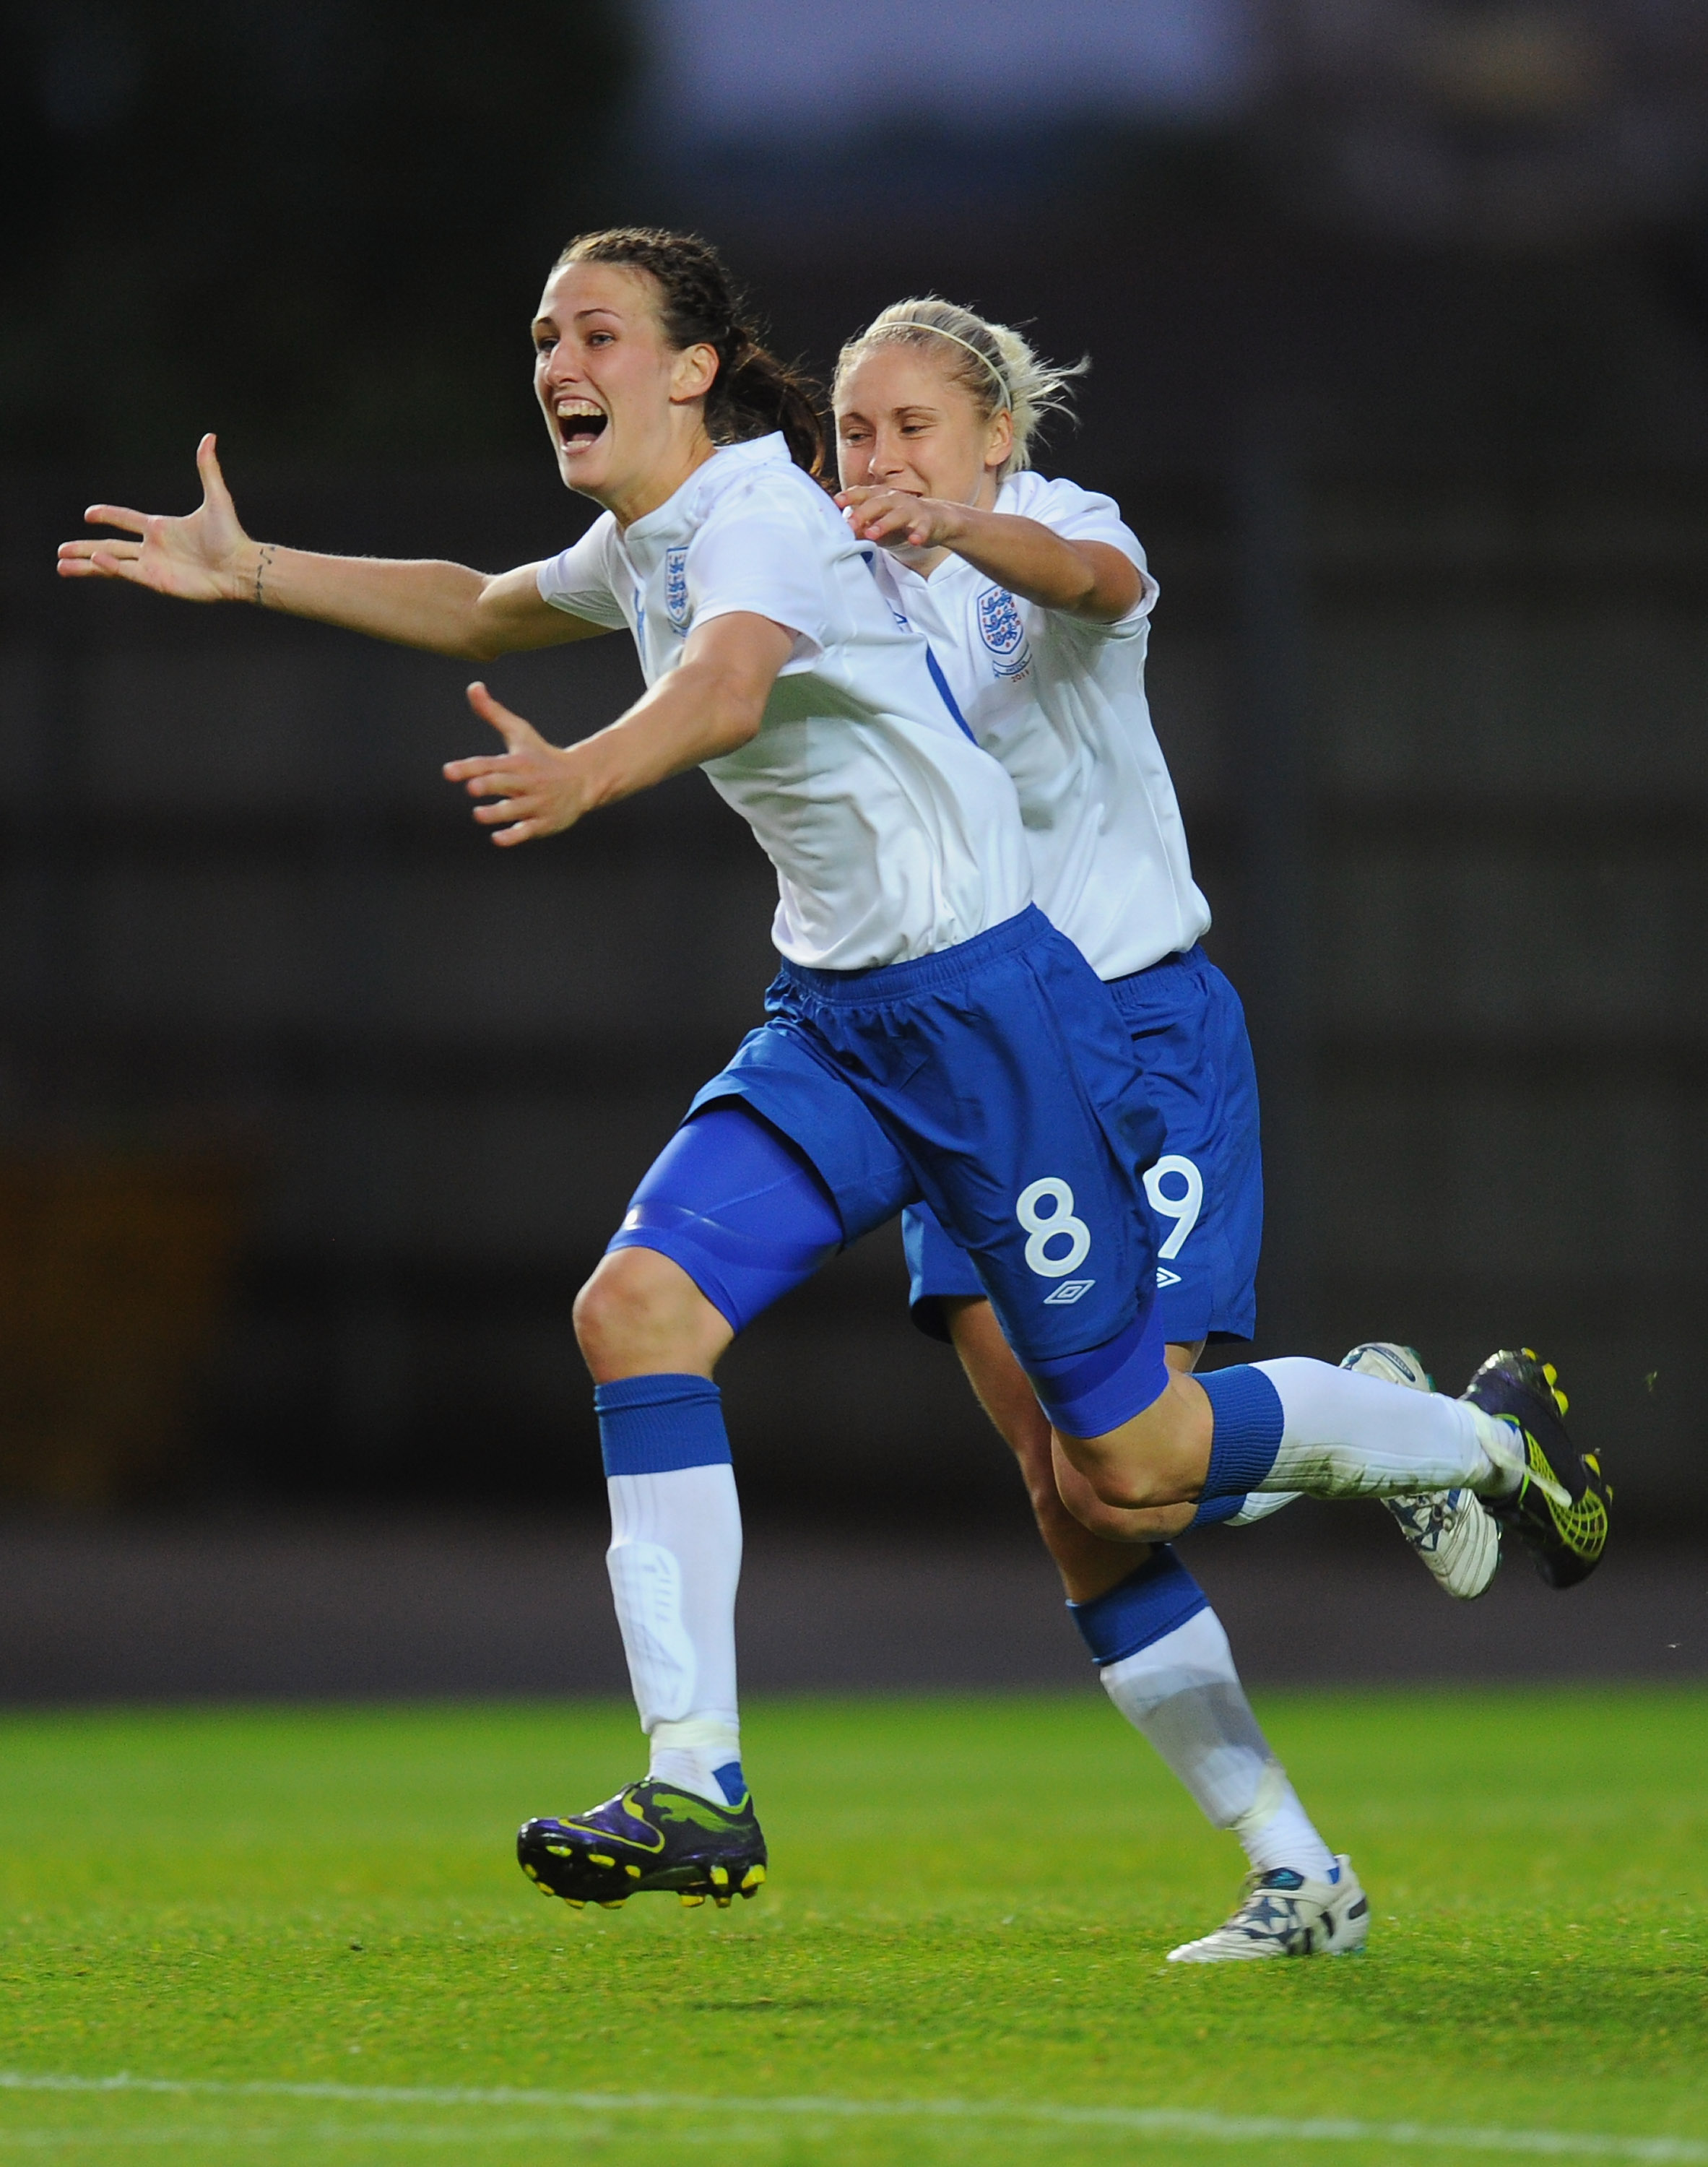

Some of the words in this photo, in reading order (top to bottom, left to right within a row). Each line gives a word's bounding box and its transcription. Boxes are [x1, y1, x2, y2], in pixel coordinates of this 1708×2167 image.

[1011, 669, 1030, 683] 2011
[1016, 1177, 1091, 1277] 8
[1143, 1155, 1203, 1260] 9
